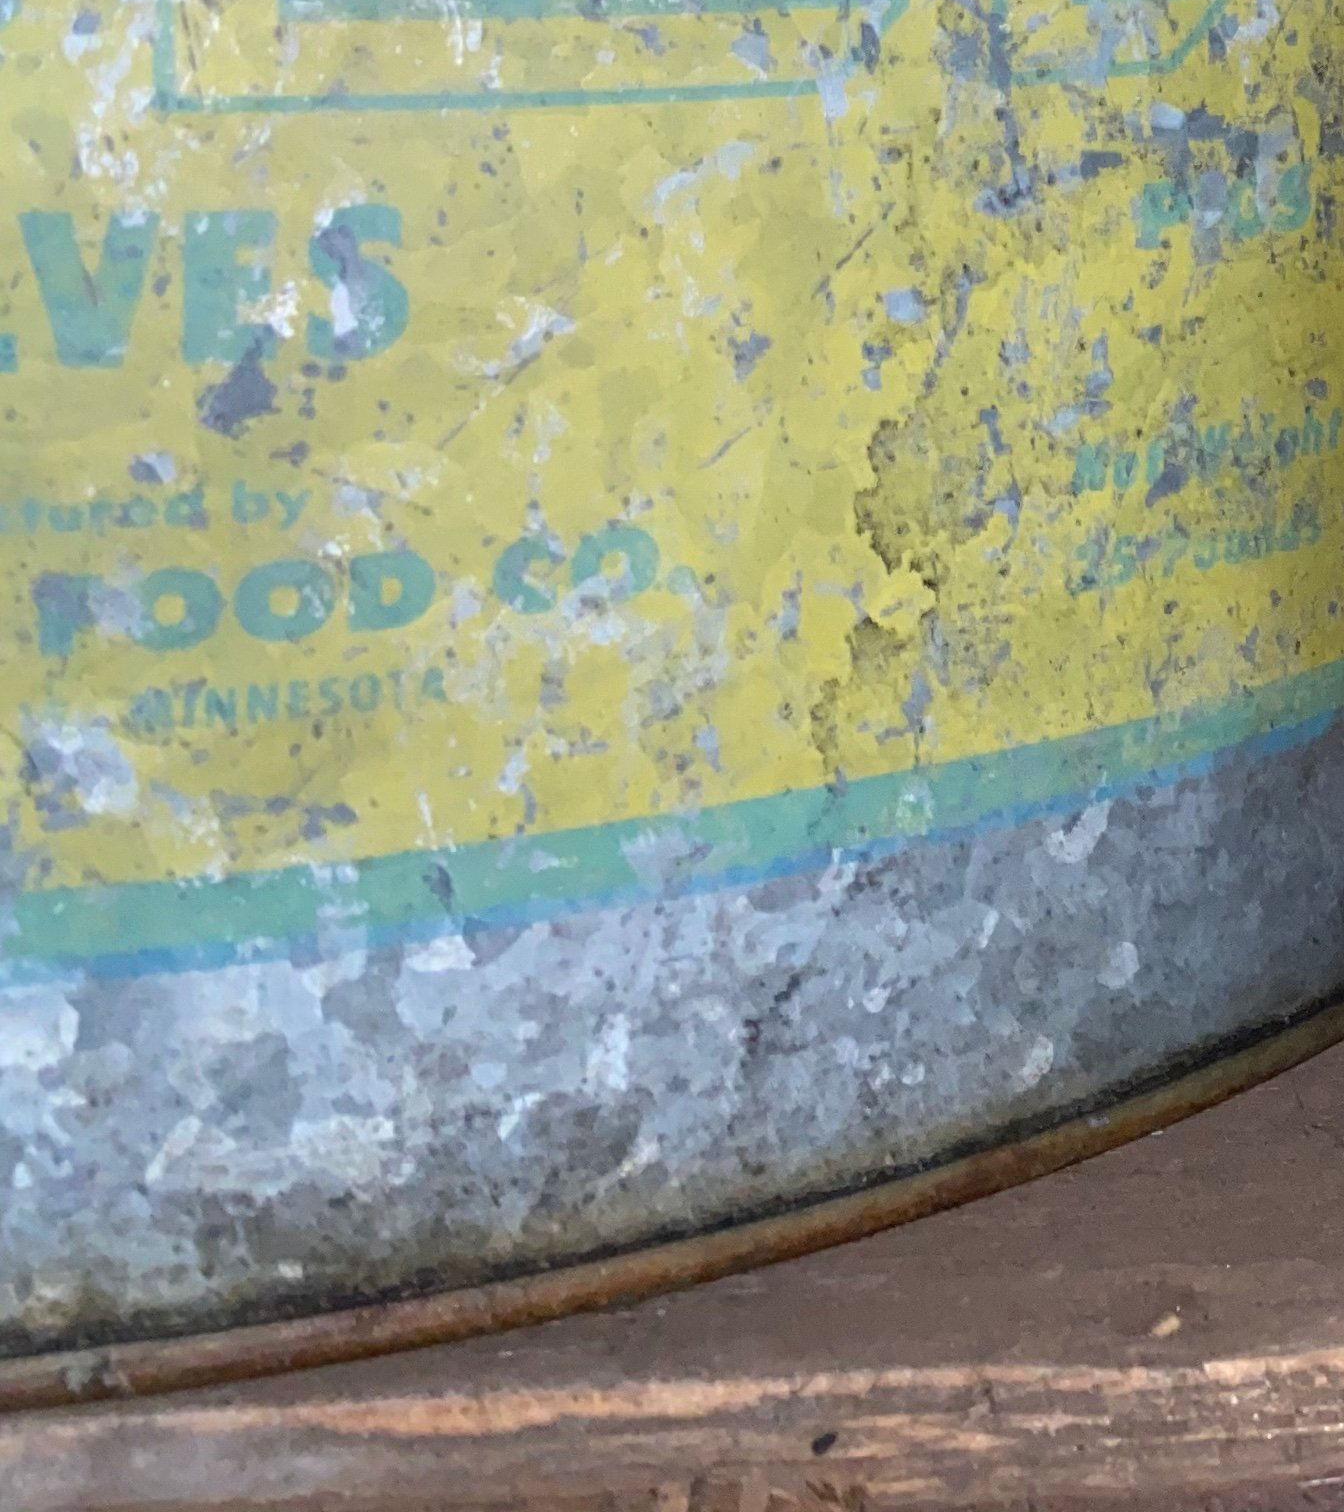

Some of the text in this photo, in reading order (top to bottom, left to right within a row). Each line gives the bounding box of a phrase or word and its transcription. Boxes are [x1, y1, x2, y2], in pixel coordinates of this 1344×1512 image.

[0, 202, 411, 374] VES
[230, 479, 312, 530] by
[31, 549, 437, 657] FOOD
